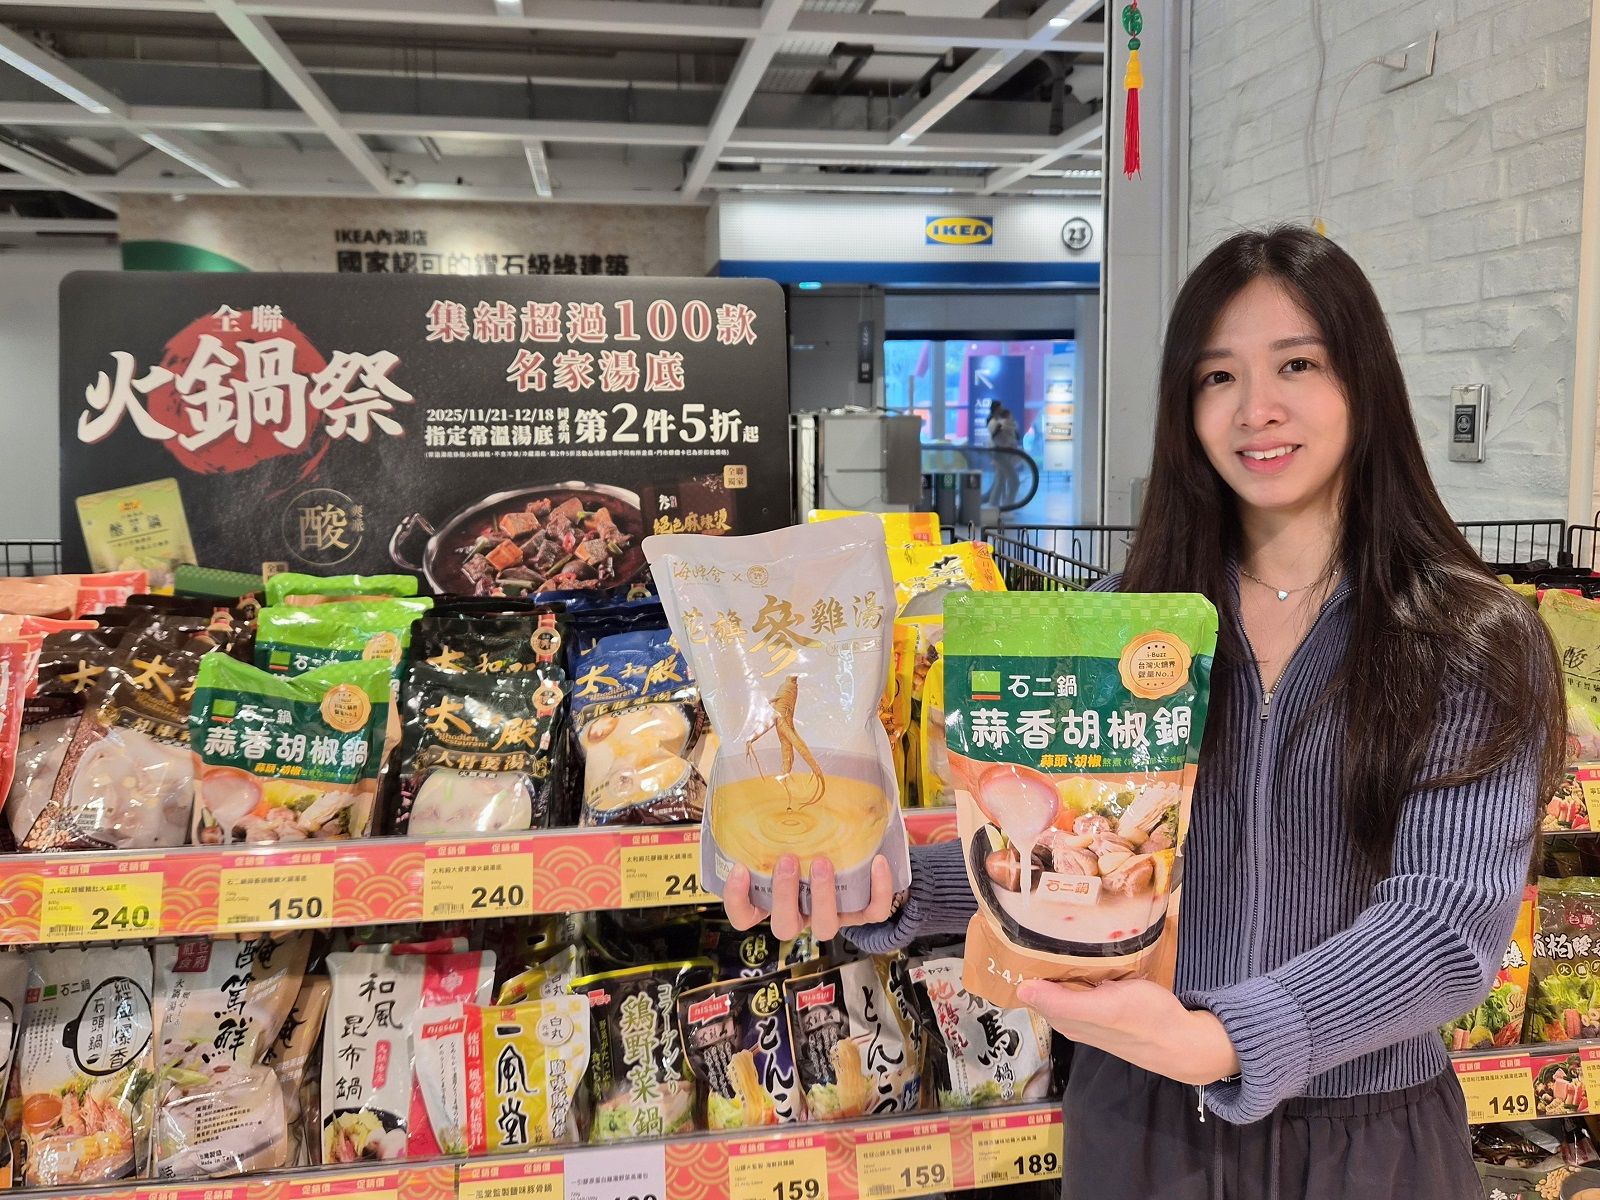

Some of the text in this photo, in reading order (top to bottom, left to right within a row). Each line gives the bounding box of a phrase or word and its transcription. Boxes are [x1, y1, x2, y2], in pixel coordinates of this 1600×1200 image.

[335, 229, 428, 245] IKEA內湖店
[933, 224, 988, 236] IKEA
[210, 303, 285, 333] 全聯
[425, 300, 758, 345] 集結超過100款
[506, 348, 685, 392] 名家湯底
[77, 334, 413, 451] 火鍋祭
[426, 408, 555, 423] 2025/11/21-12/18
[424, 425, 554, 446] 指定常溫湯底
[298, 503, 350, 552] 酸
[680, 590, 884, 678] 花旗參雞湯
[574, 654, 683, 698] 太和殿
[1008, 674, 1078, 698] 石二鍋
[969, 706, 1192, 750] 蒜香胡椒鍋
[203, 725, 369, 769] 蒜香胡椒鍋
[438, 845, 467, 856] 促銷價
[491, 842, 520, 853] 促銷價
[632, 834, 659, 845] 促銷價
[58, 864, 91, 876] 促銷價
[118, 861, 150, 872] 促銷價
[665, 872, 710, 897] 24
[1046, 878, 1090, 895] 石二鍋
[470, 884, 525, 909] 240
[91, 905, 150, 931] 240
[268, 896, 323, 921] 150
[60, 979, 91, 996] 石二鍋
[359, 972, 403, 1029] 和風
[550, 1016, 564, 1040] 白丸
[335, 1015, 369, 1101] 昆布鍋
[621, 993, 663, 1139] 鶏野菜鍋
[1459, 1062, 1481, 1072] 促銷價
[1499, 1058, 1521, 1068] 促銷價
[757, 1017, 795, 1122] とんこ
[497, 1025, 538, 1147] 一風堂
[1489, 1094, 1530, 1115] 149
[866, 1132, 892, 1141] 促銷價
[913, 1126, 938, 1135] 促銷價
[739, 1143, 765, 1153] 促銷價
[788, 1140, 814, 1149] 促銷價
[471, 1168, 499, 1179] 促銷價
[523, 1163, 550, 1174] 促銷價
[1013, 1152, 1058, 1175] 189
[356, 1180, 385, 1190] 促銷價
[900, 1163, 946, 1188] 159
[301, 1184, 331, 1195] 促銷價
[772, 1178, 820, 1200] 159
